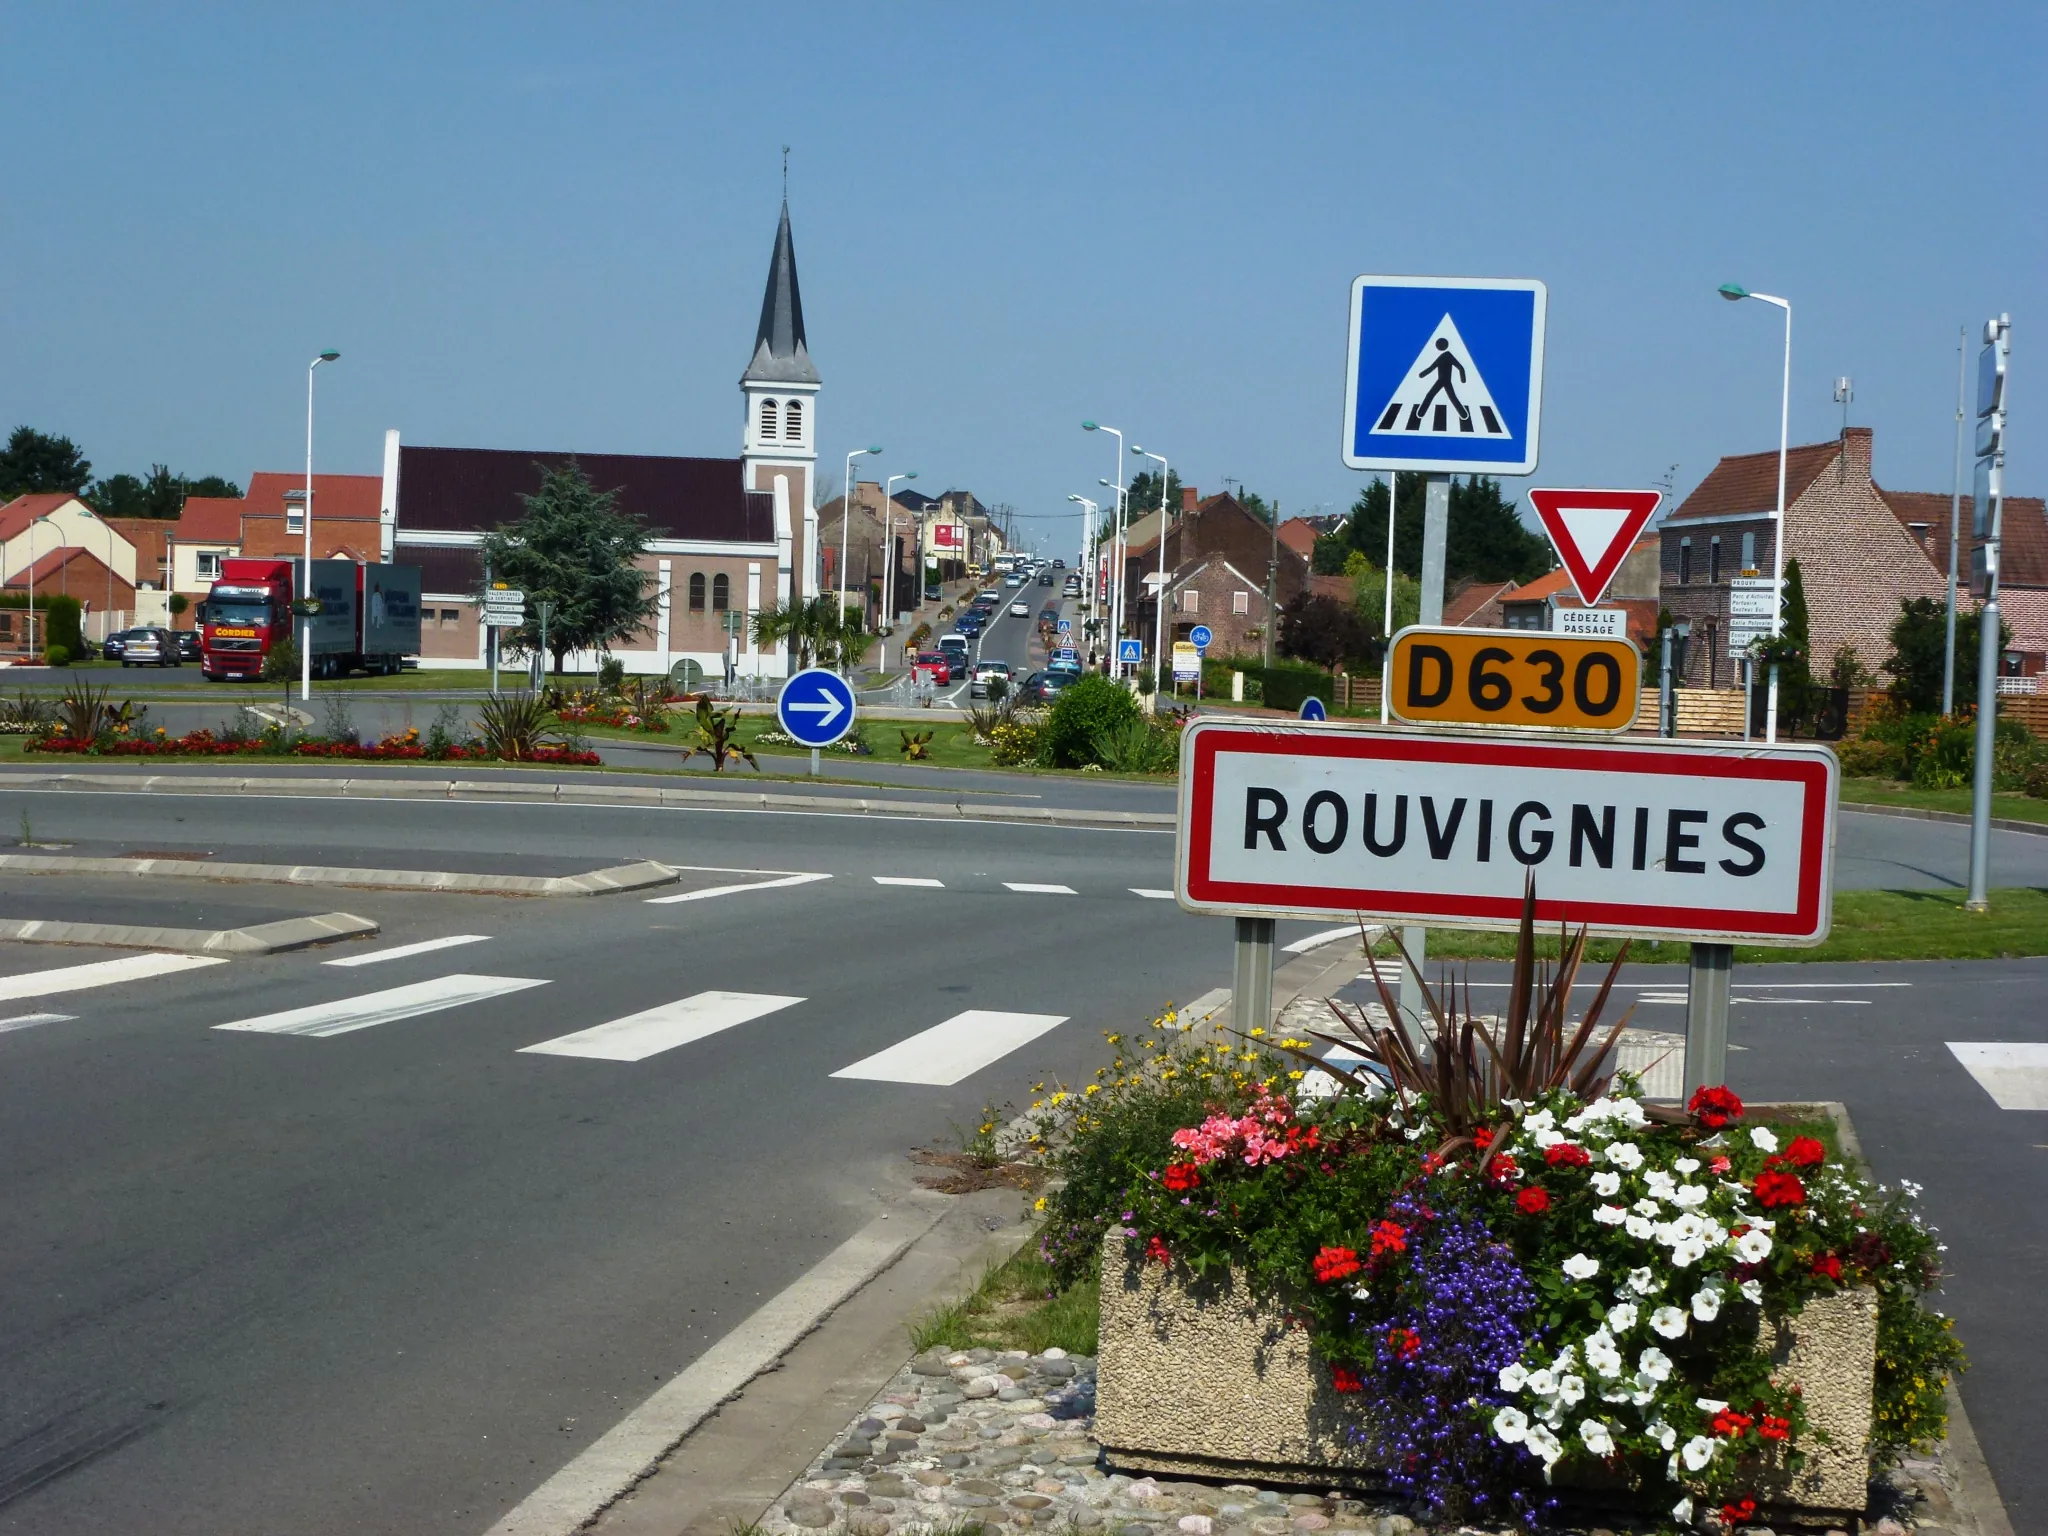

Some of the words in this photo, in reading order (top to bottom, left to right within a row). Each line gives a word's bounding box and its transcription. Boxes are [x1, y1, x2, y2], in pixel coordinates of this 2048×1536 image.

[1563, 612, 1599, 623] CÉDEZ
[1602, 614, 1616, 623] LE
[215, 628, 255, 637] CORDIER
[1564, 625, 1614, 635] PASSAGE
[1244, 787, 1767, 877] ROUVIGNIES
